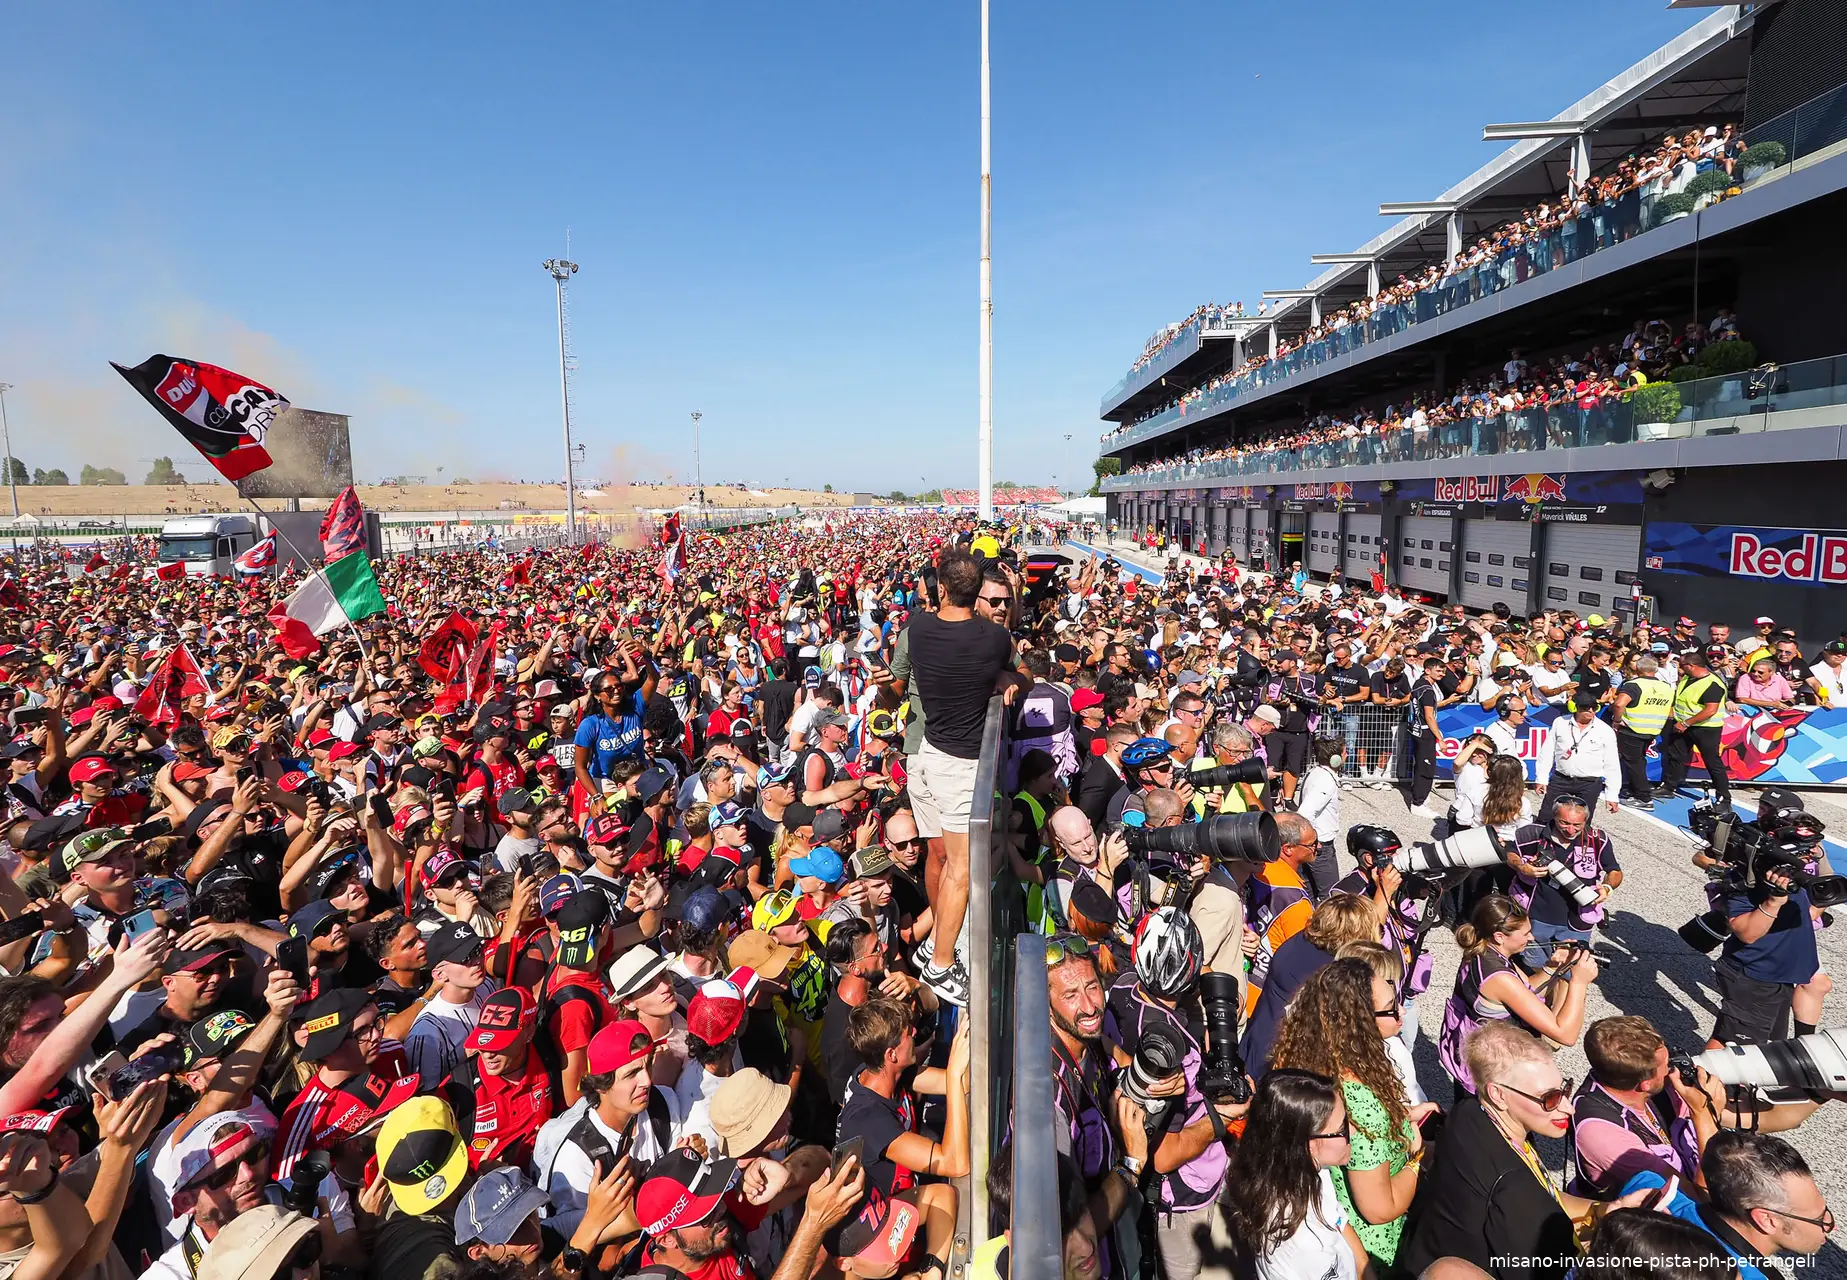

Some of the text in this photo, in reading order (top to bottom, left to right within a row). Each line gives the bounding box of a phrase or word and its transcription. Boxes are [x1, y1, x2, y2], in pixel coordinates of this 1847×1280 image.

[1294, 484, 1307, 499] Red
[1434, 475, 1499, 502] Red Bull
[1565, 513, 1588, 522] VIÑALES
[1729, 533, 1818, 581] Red
[1517, 729, 1547, 758] ull
[598, 815, 622, 833] 63
[427, 851, 455, 873] 23
[560, 926, 587, 943] 46
[479, 1003, 516, 1027] 63
[365, 1073, 388, 1099] 6
[316, 1121, 339, 1141] DUCATI
[337, 1103, 360, 1125] CORSE
[492, 1186, 522, 1212] MASERATI
[660, 1193, 691, 1226] CORSE
